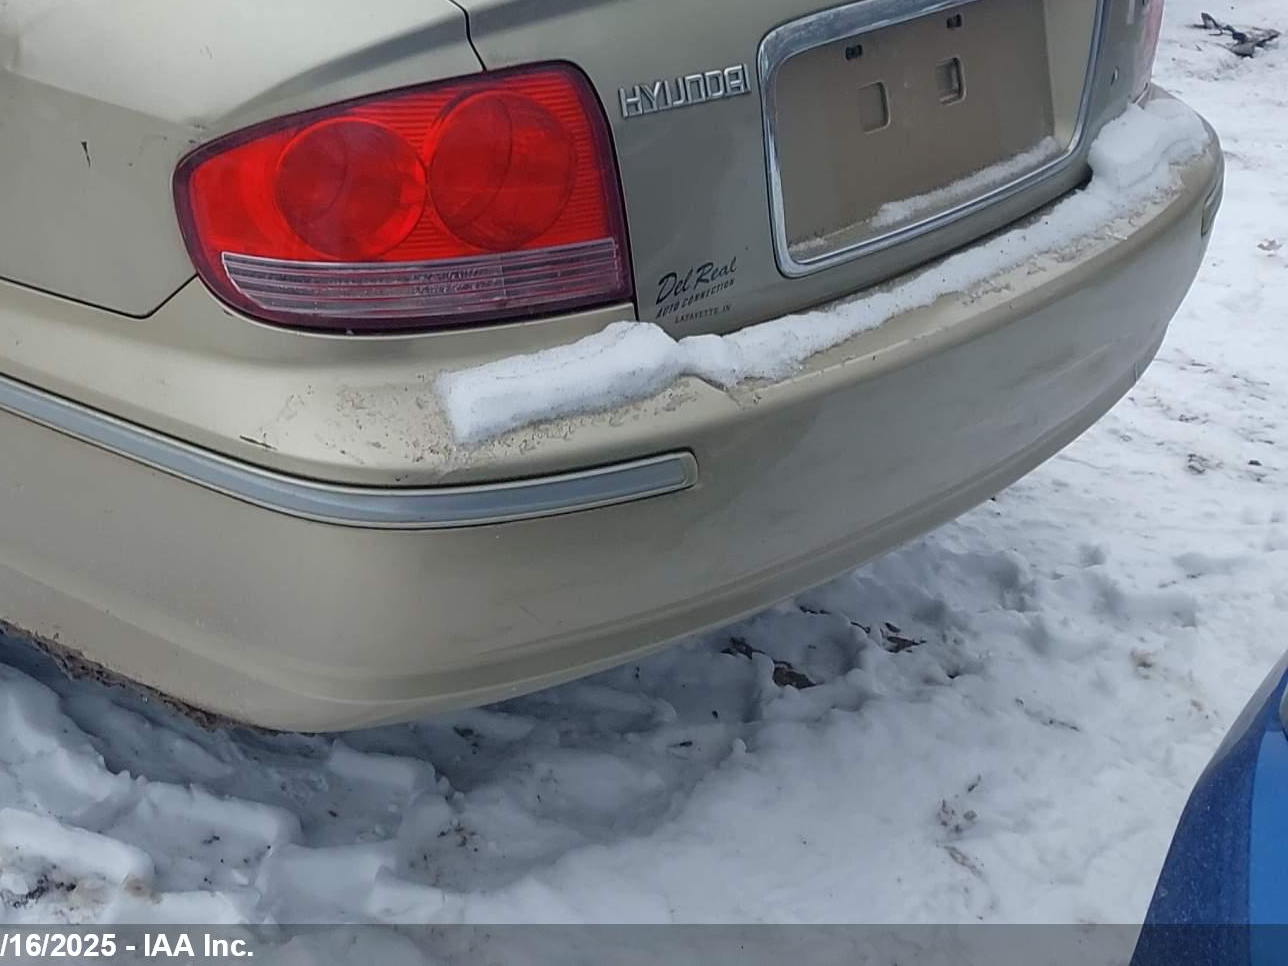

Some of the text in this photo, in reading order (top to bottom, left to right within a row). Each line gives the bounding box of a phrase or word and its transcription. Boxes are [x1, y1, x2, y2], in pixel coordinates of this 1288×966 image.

[618, 63, 752, 119] HYUNDAI
[655, 255, 737, 305] Del Real
[655, 277, 736, 319] AUTO CONNECTION
